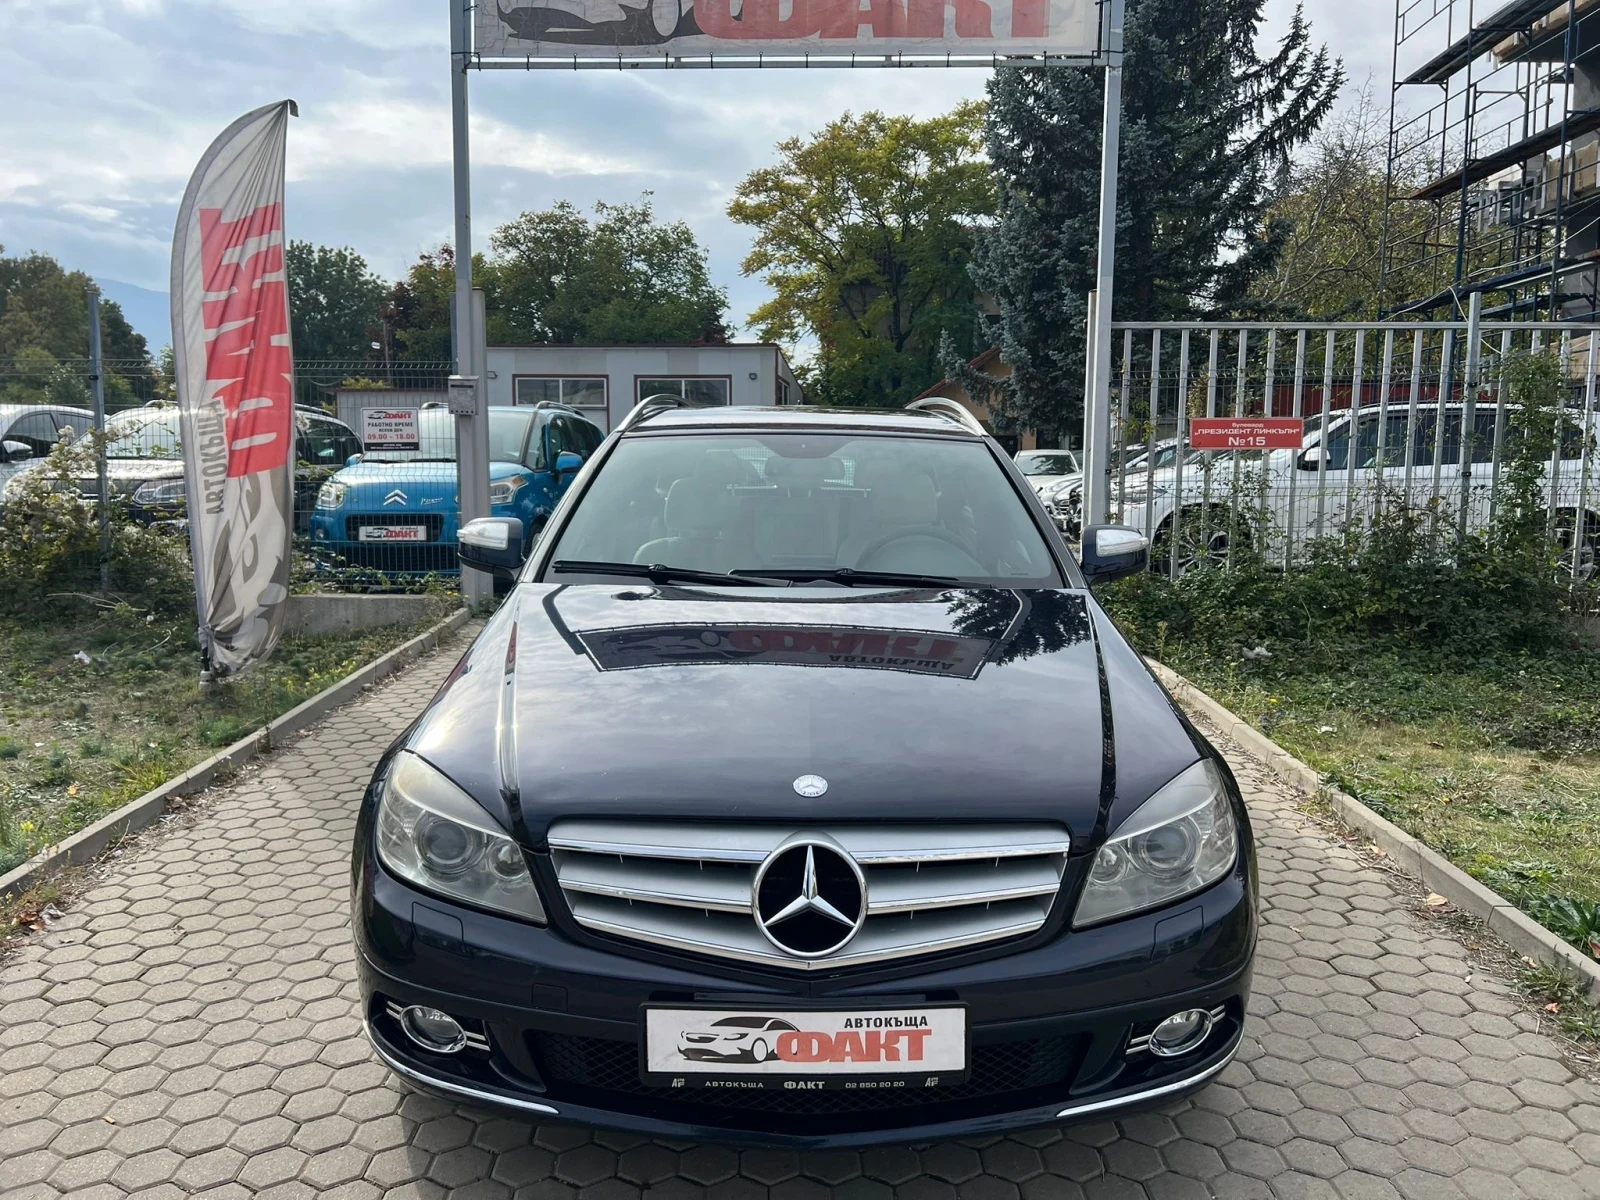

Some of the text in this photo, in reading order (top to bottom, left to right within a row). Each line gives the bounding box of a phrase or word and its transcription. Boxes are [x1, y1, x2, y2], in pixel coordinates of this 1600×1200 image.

[200, 202, 293, 477] ФАКТ
[1228, 436, 1266, 446] №15
[844, 1015, 929, 1029] АВТОКЪЩА
[776, 1028, 933, 1063] ФАКТ
[783, 1080, 825, 1089] ФАКТ
